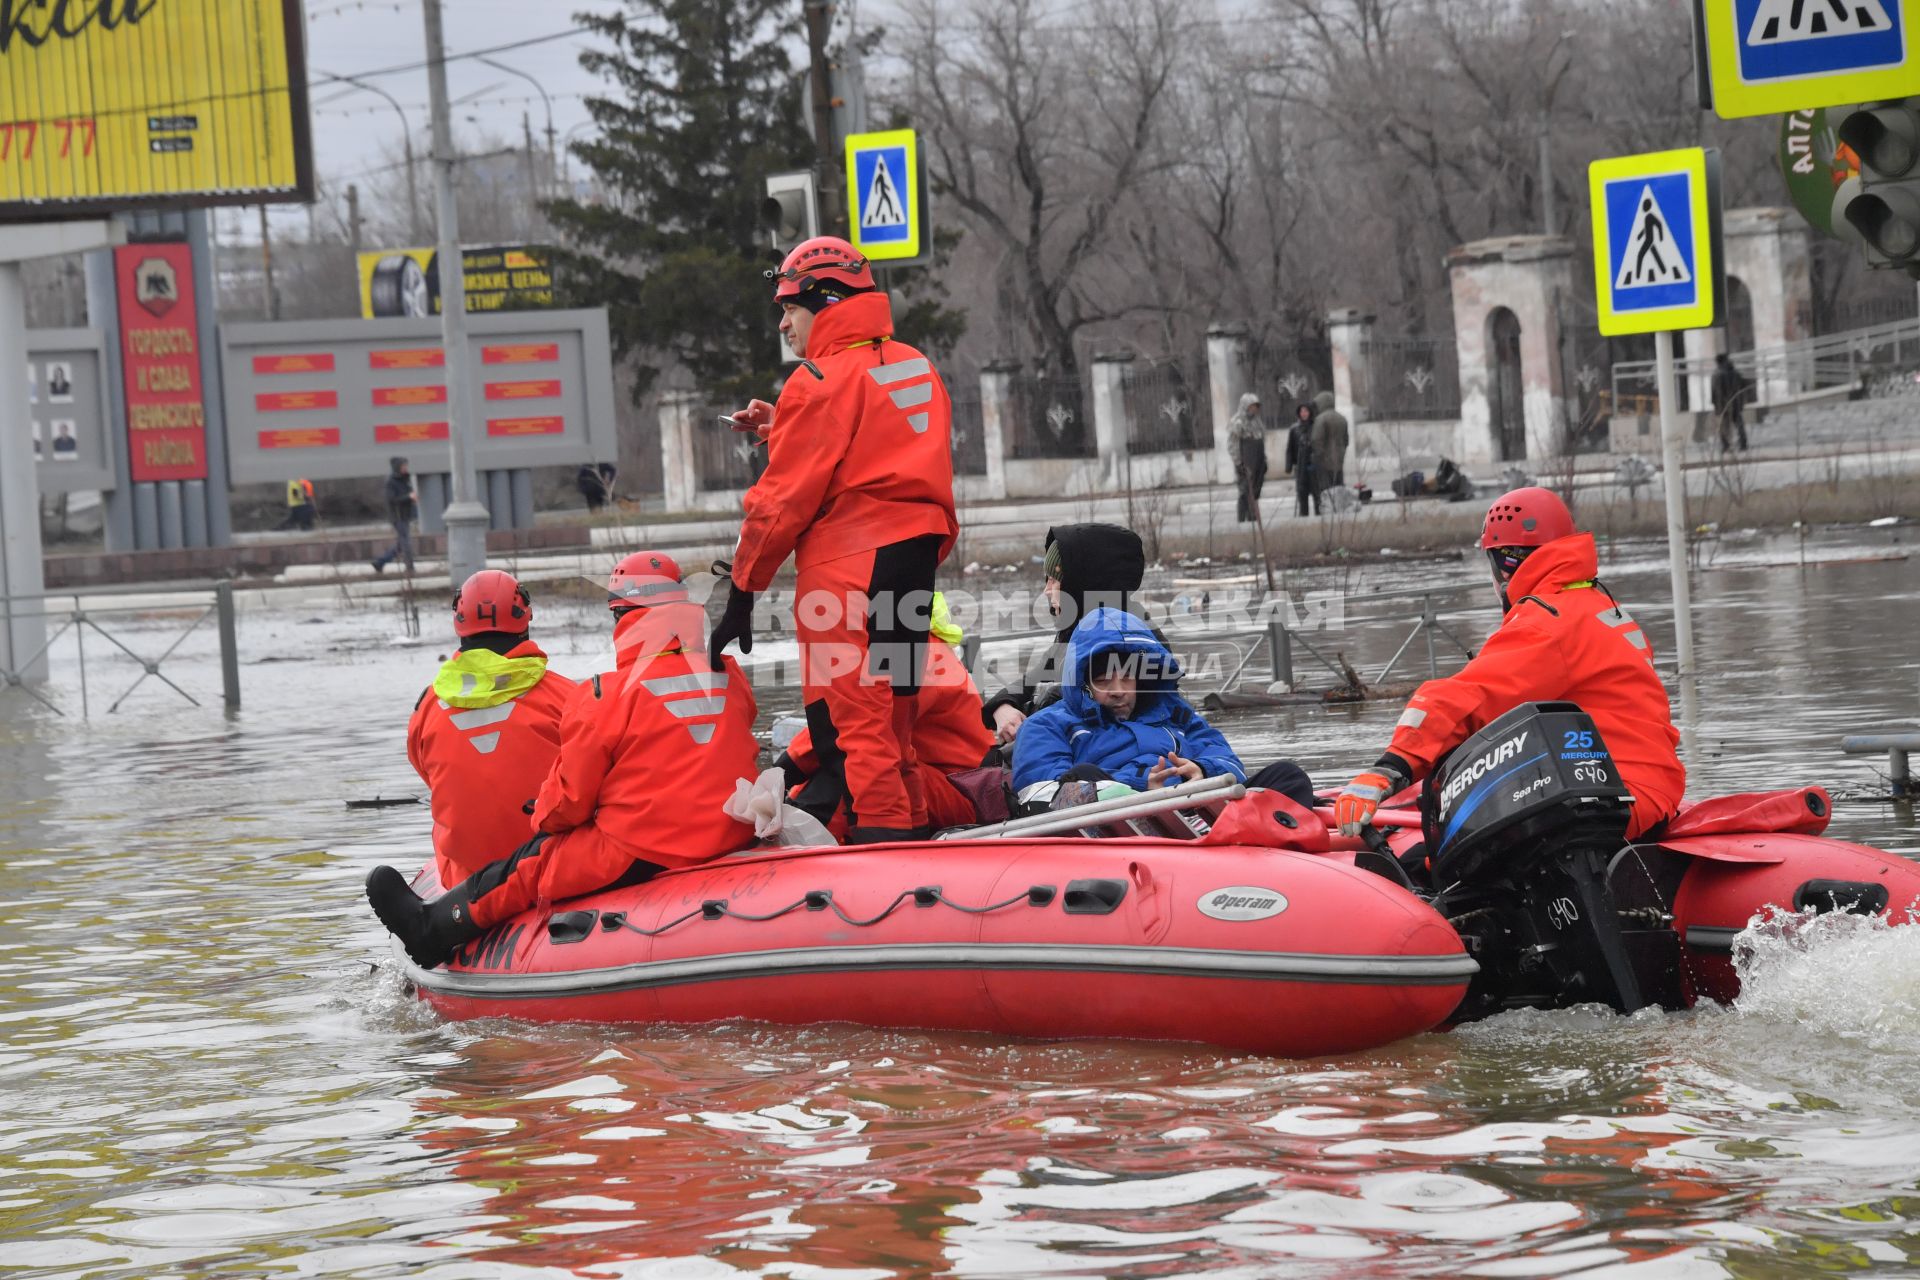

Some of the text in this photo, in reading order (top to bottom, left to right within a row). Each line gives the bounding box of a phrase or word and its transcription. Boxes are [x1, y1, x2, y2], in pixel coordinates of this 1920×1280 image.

[54, 118, 96, 159] 77
[128, 327, 193, 358] ГОРДОСТЬ
[136, 365, 191, 392] И СЛАВА
[130, 402, 205, 430] ЛЕНИНСКОГО
[144, 434, 195, 466] РАЙОНА
[1563, 731, 1594, 749] 25
[1560, 752, 1608, 760] MERCURY
[1439, 731, 1529, 822] MERCURY
[1512, 776, 1551, 802] Sea Pro
[1212, 893, 1278, 911] Фрегат
[1547, 897, 1579, 930] 640
